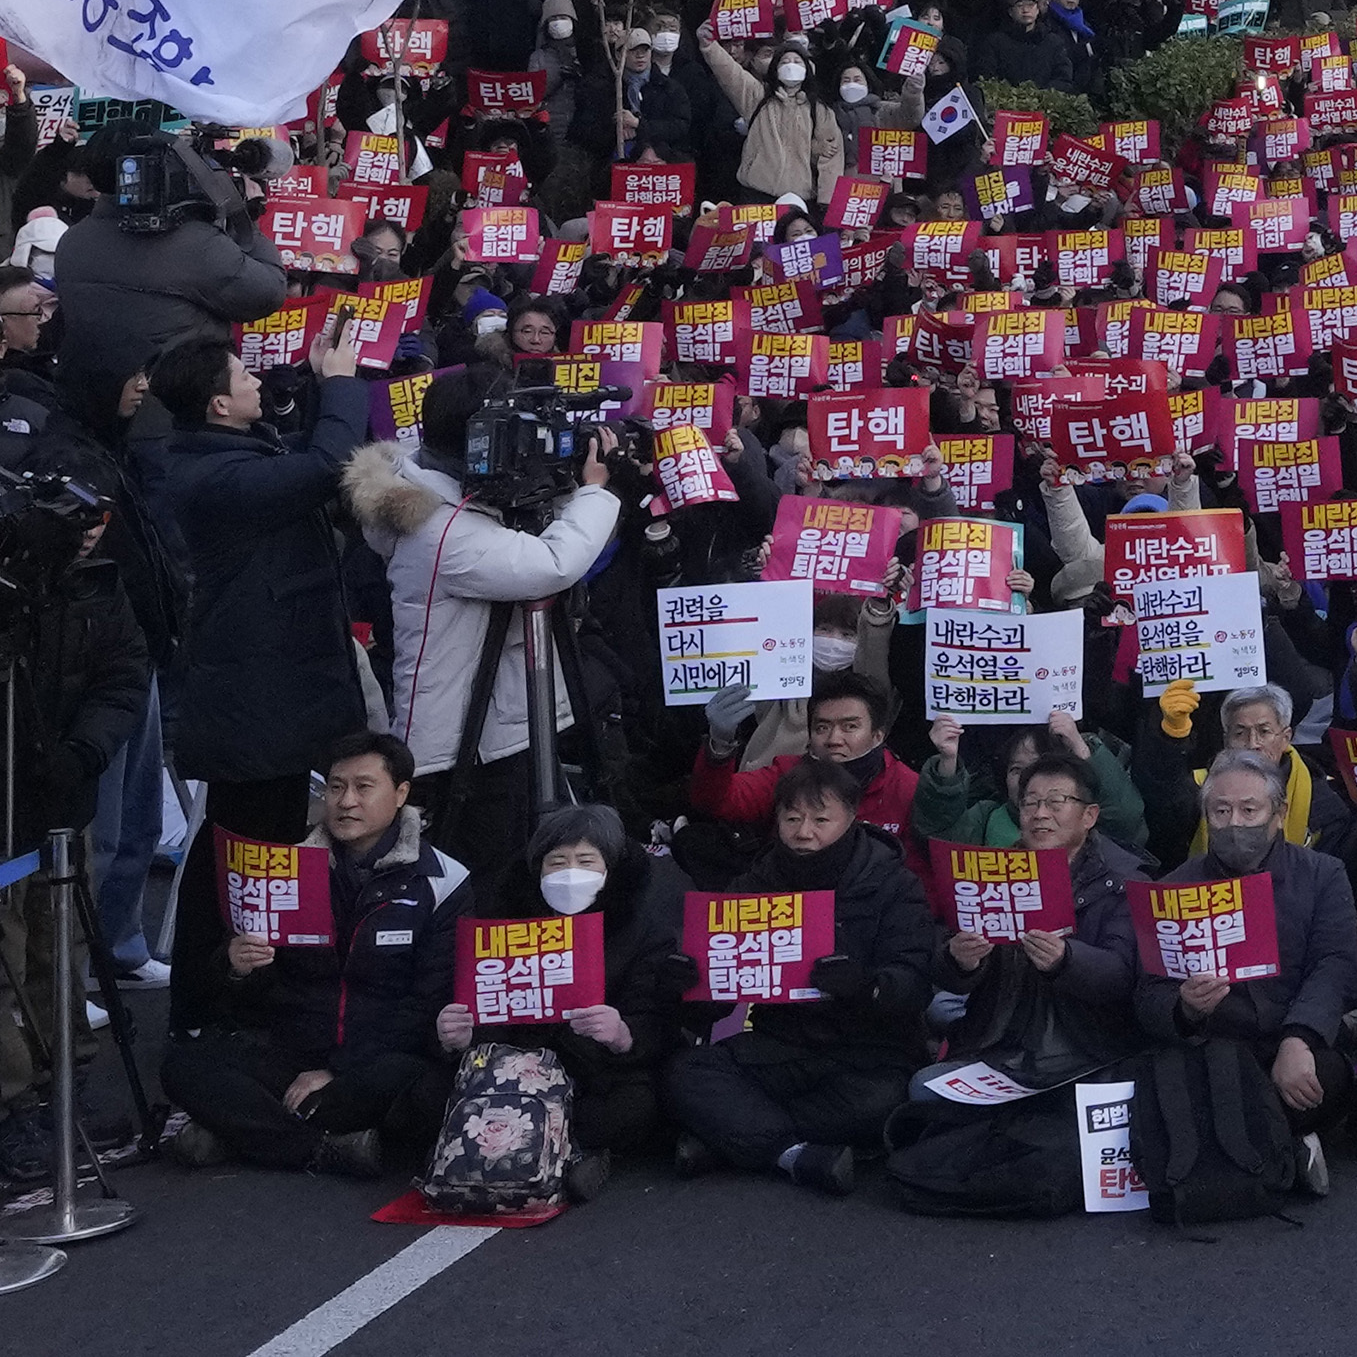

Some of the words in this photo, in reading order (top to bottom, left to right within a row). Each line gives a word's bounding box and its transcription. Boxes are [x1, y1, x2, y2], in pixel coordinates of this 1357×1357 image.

[273, 212, 344, 245] 탄핵
[610, 215, 664, 248] 탄핵
[826, 406, 904, 450] 탄핵
[1069, 414, 1150, 457] 탄핵
[803, 504, 873, 531] 내란죄
[796, 529, 870, 558] 윤석열
[923, 523, 991, 551] 내란죄
[1125, 538, 1218, 563] 내란수괴
[791, 553, 848, 581] 퇴진!
[921, 549, 991, 579] 윤석열
[920, 577, 974, 605] 탄핵!
[1137, 588, 1203, 617] 내란수괴
[665, 595, 729, 622] 권력을
[667, 630, 704, 653] 다시
[779, 639, 806, 648] 노동당
[934, 620, 1025, 647] 내란수괴
[1139, 621, 1205, 648] 윤석열을
[1230, 630, 1256, 640] 노동당
[671, 663, 751, 689] 시민에게
[932, 653, 1024, 679] 윤석열을
[1052, 665, 1077, 677] 노동당
[1141, 653, 1210, 681] 탄핵하라
[932, 687, 1029, 713] 탄핵하라
[226, 847, 300, 878] 내란죄
[951, 850, 1039, 881] 내란죄
[226, 873, 299, 912] 윤석열
[954, 879, 1042, 912] 윤석열
[1150, 879, 1244, 920] 내란죄
[709, 896, 803, 932] 내란죄
[475, 918, 574, 958] 내란죄
[1156, 910, 1246, 948] 윤석열
[708, 926, 803, 966] 윤석열
[475, 951, 574, 990] 윤석열
[709, 966, 782, 1001] 탄핵!
[476, 986, 555, 1022] 탄핵!
